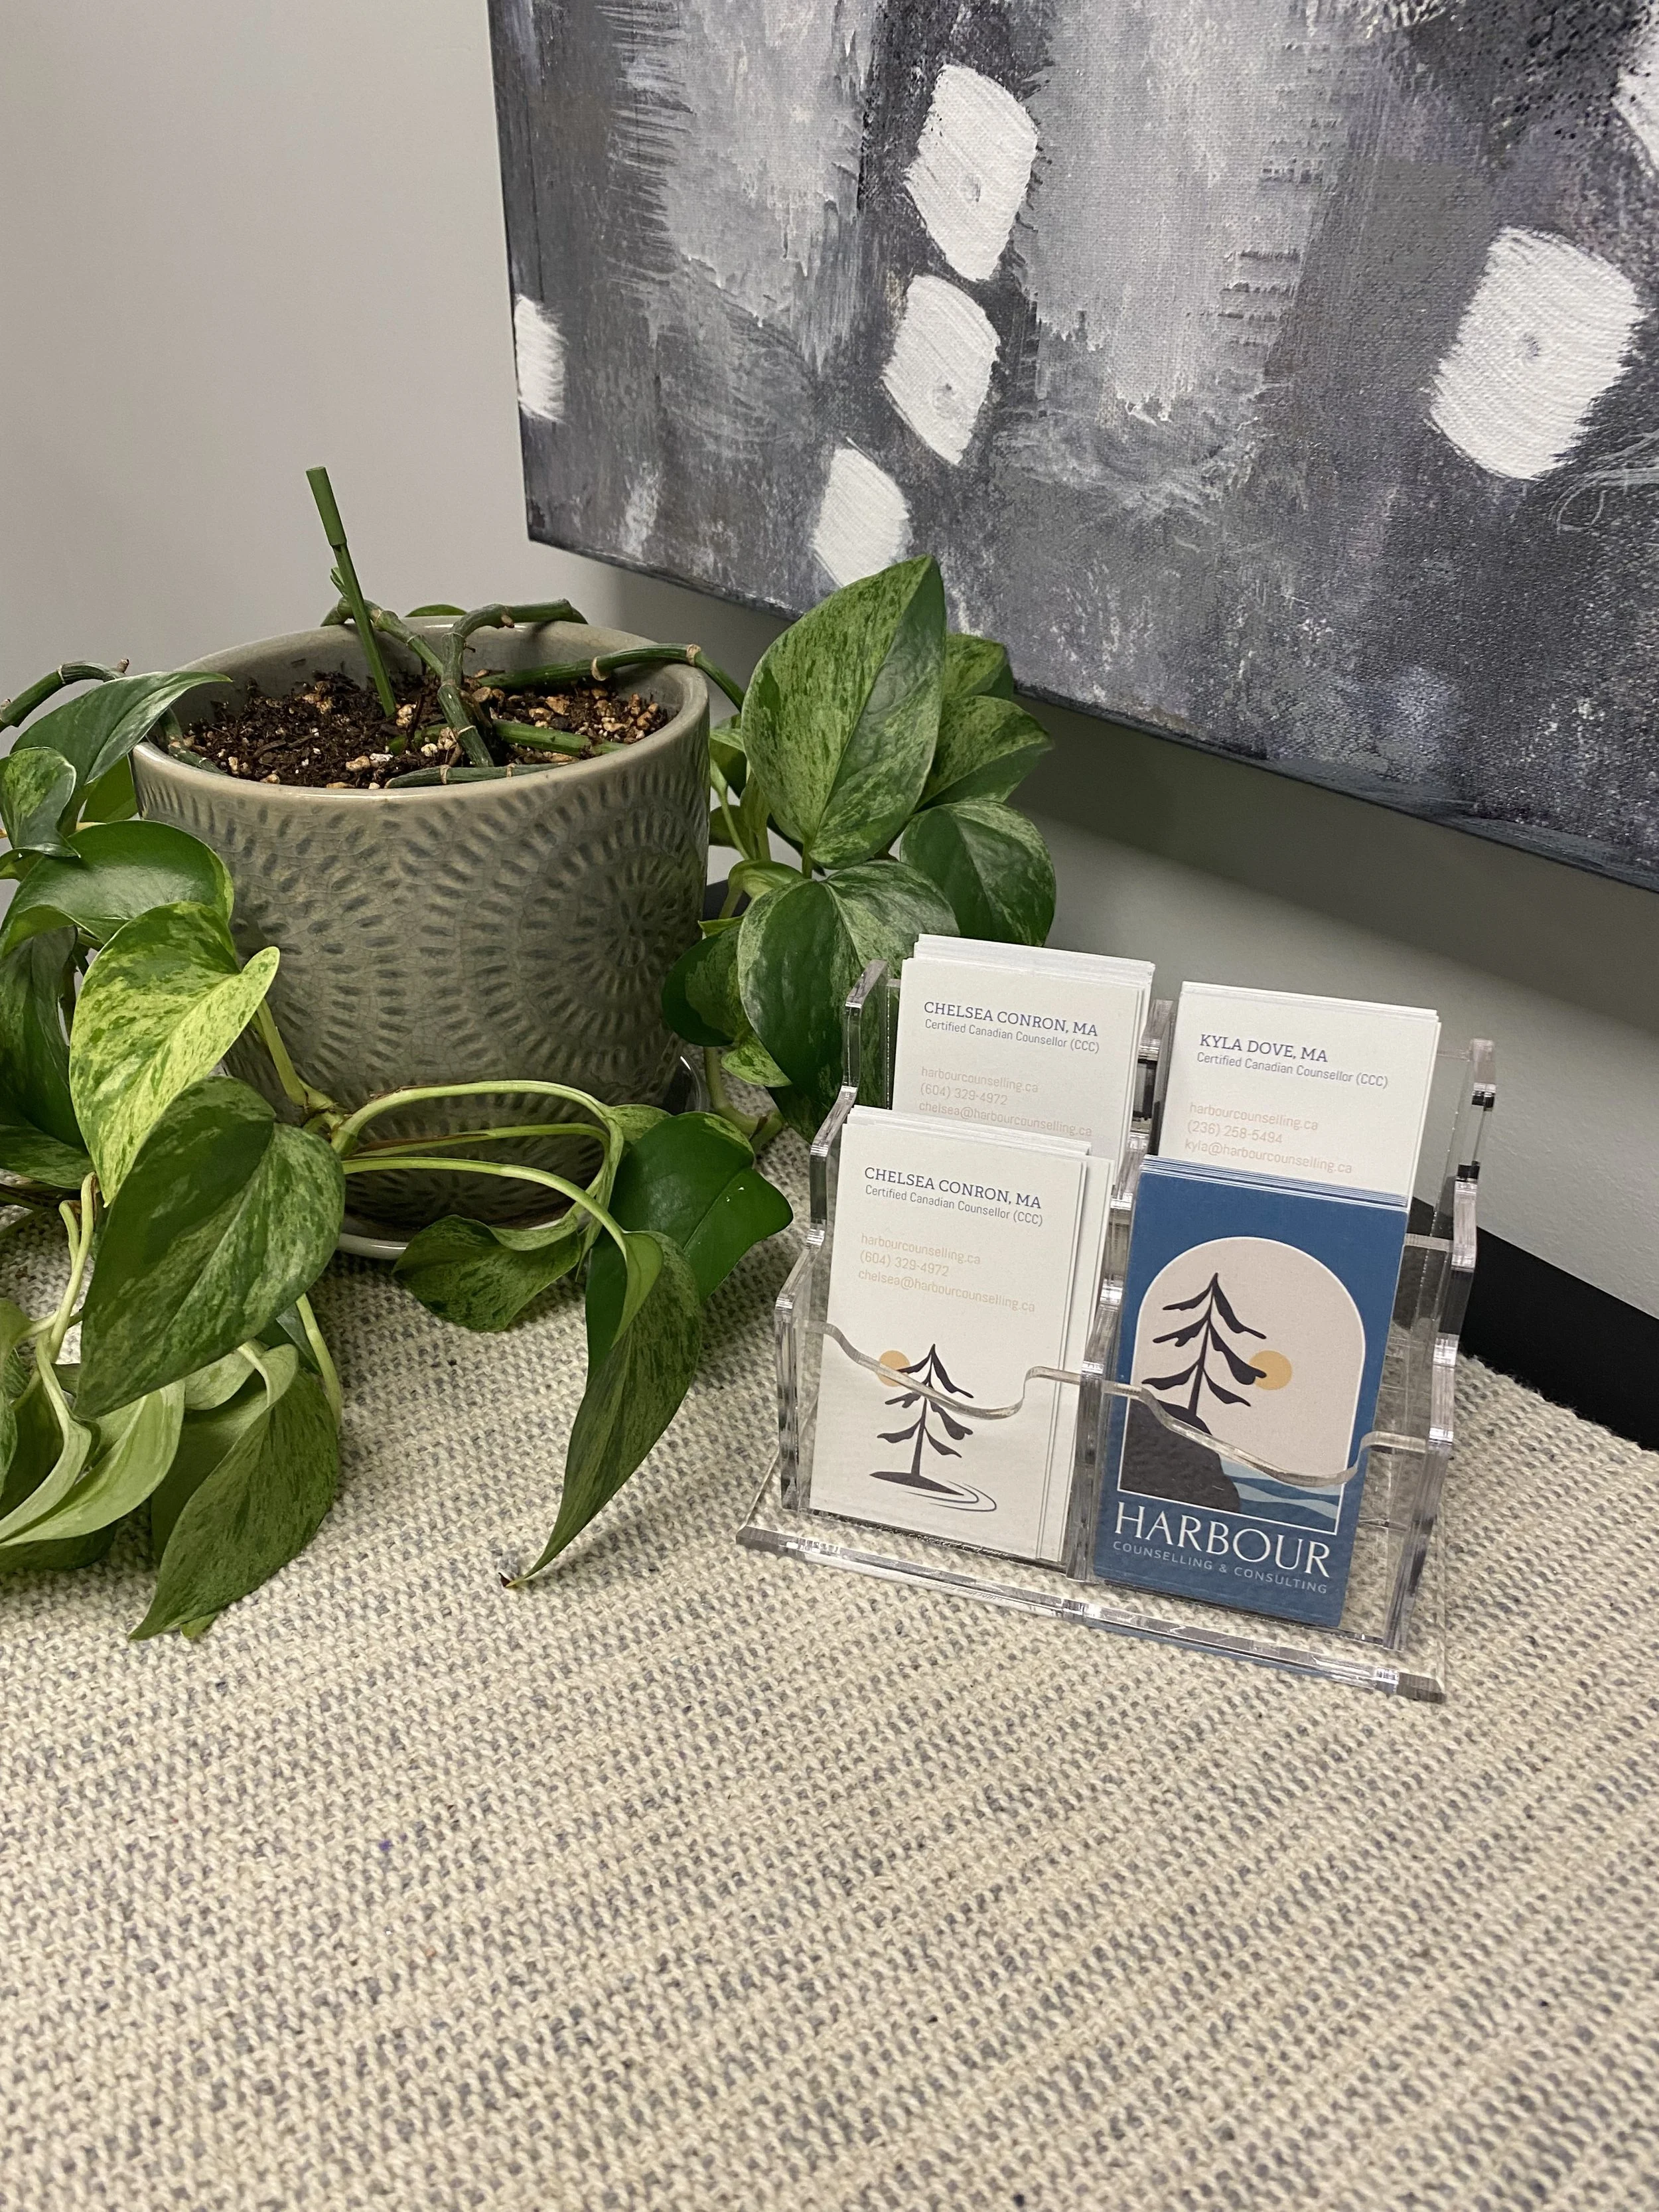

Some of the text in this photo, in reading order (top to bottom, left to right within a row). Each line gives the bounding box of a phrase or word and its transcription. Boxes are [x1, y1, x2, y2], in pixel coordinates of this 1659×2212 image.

[924, 1002, 1098, 1036] CHELSEA CONRON, MA
[925, 1019, 1099, 1054] Certified Canadian Counsellor (CCC)
[1200, 1034, 1328, 1062] KYLA DOVE, MA
[922, 1066, 1038, 1092] harbourcounselling.ca
[1197, 1052, 1388, 1089] Certified Canadian Counsellor (CCC)
[920, 1083, 1007, 1105] (604) 329-4972
[919, 1102, 1092, 1136] chelsea@harbourcounselling.ca
[1188, 1120, 1283, 1143] (236) 258-5494
[1190, 1102, 1318, 1130] harbourcounselling.ca
[1185, 1139, 1352, 1173] kyla@harbourcounselling.ca
[865, 1167, 1041, 1209] CHELSEA CONRON, MA
[865, 1185, 1043, 1226] Certified Canadian Counsellor (CCC)
[860, 1250, 949, 1277] (604) 329-4972
[861, 1233, 981, 1264] harbourcounselling.ca
[859, 1269, 1035, 1312] chelsea@harbourcounselling.ca
[1115, 1502, 1330, 1578] HARBOUR
[1114, 1541, 1327, 1593] COUNSELLING & CONSULTING
